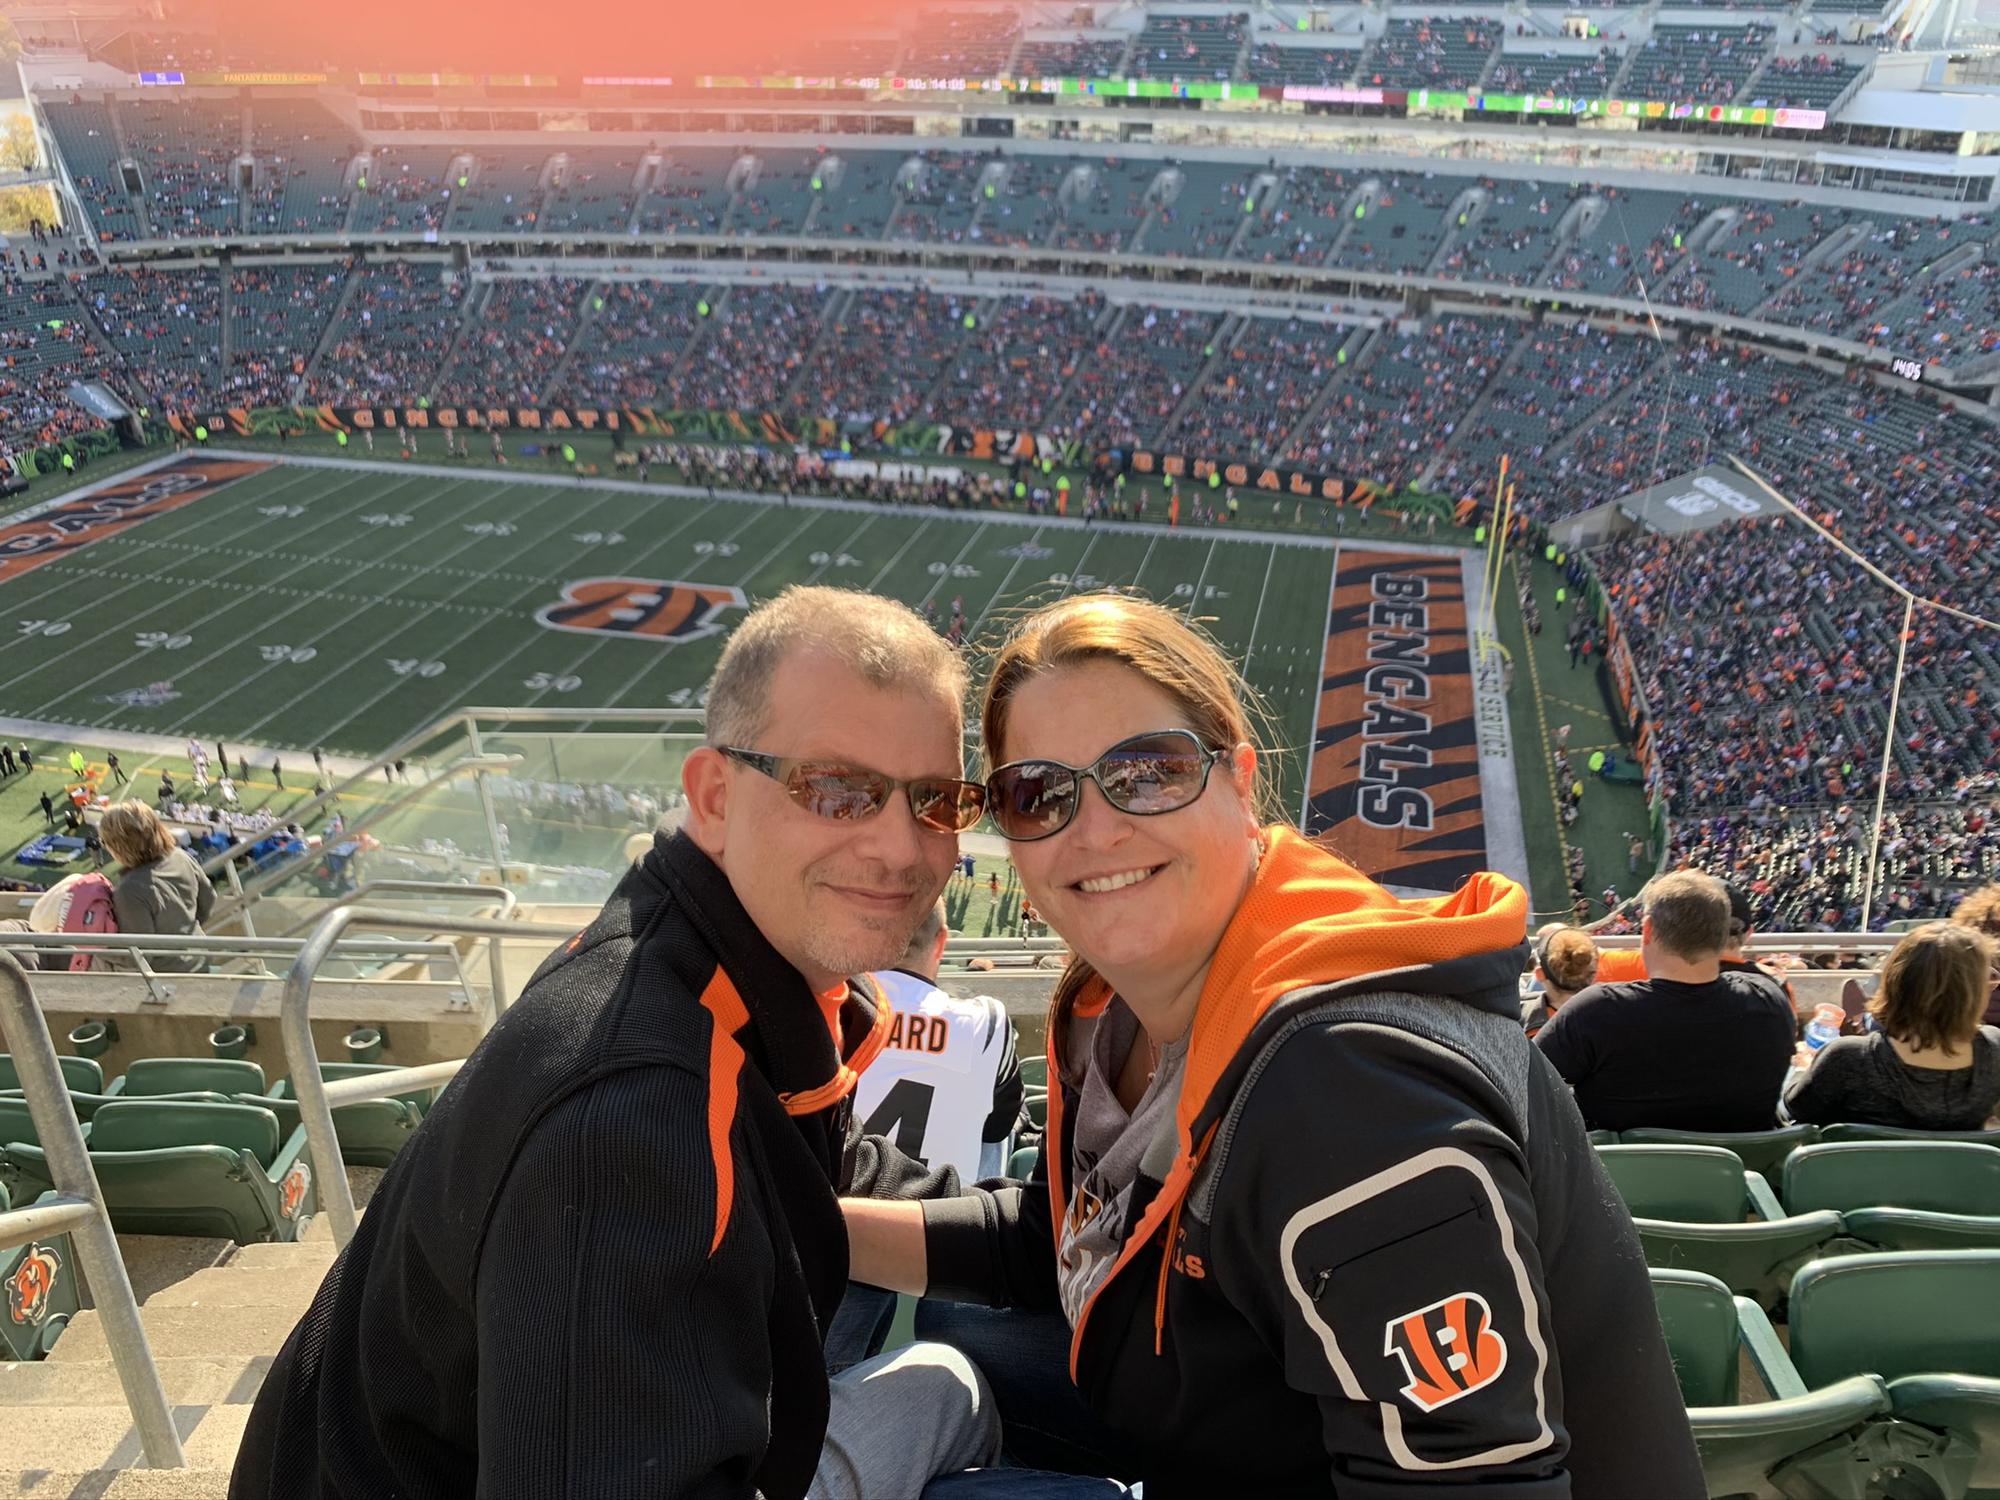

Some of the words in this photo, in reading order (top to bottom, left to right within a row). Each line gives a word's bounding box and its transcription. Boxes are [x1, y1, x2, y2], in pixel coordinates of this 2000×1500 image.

[353, 408, 620, 430] CINCINNATI
[1132, 450, 1344, 499] BENGALS
[1357, 571, 1434, 832] BENGALS
[1384, 1291, 1508, 1413] B
